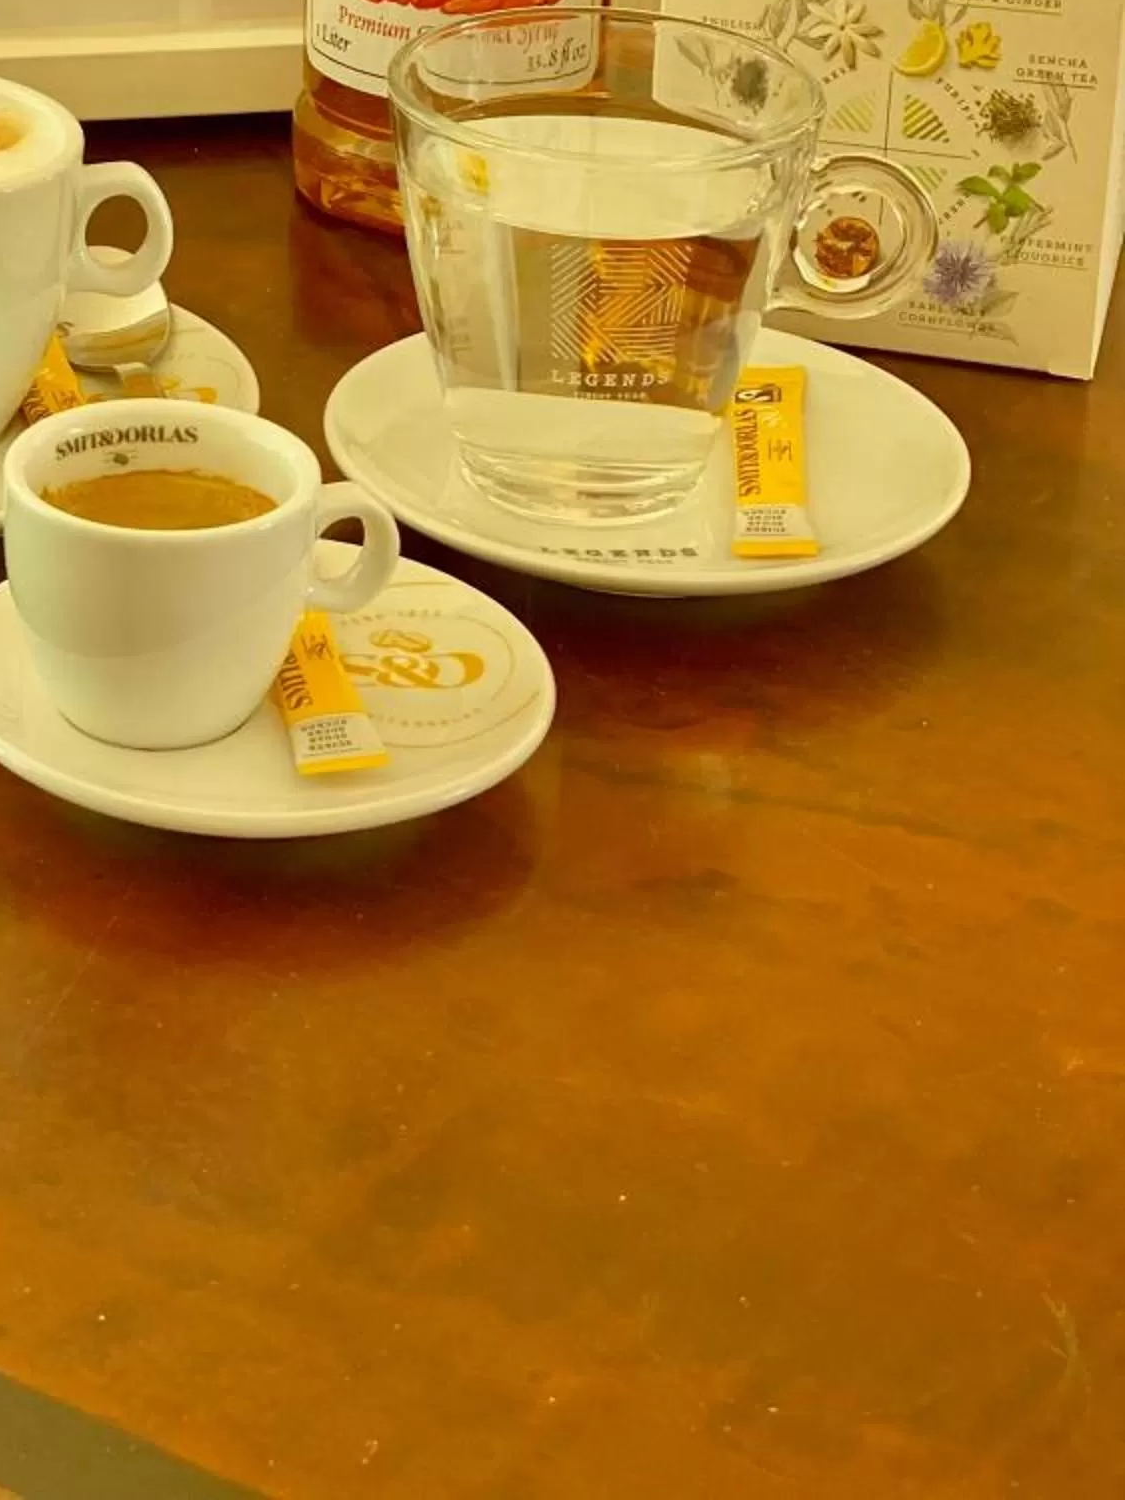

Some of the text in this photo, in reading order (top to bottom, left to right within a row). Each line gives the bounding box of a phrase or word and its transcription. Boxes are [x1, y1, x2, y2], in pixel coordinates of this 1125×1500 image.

[338, 4, 411, 41] Premium
[551, 369, 669, 388] LEGENDS
[55, 426, 199, 461] SMIT&DORLAS
